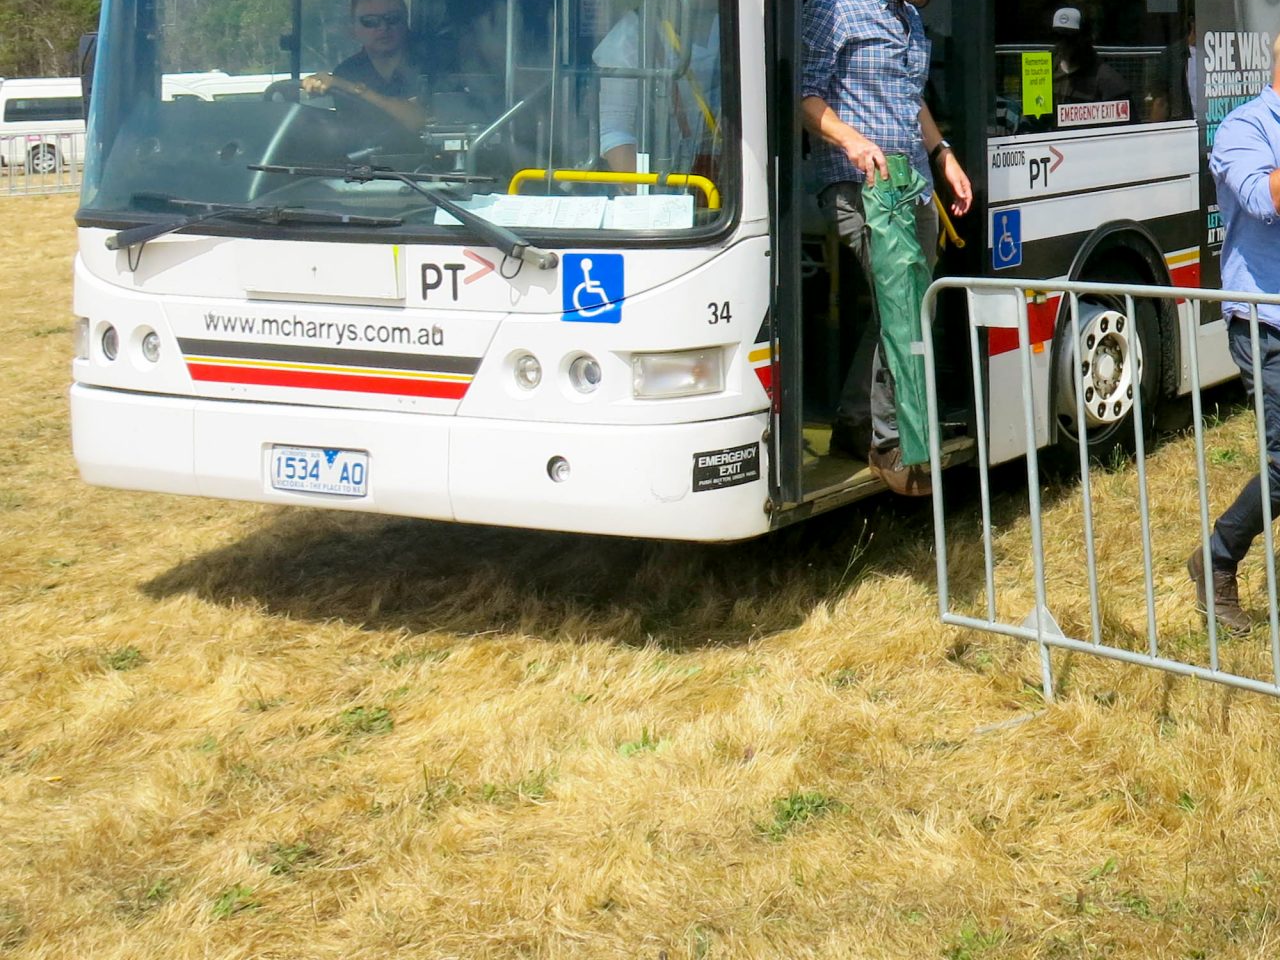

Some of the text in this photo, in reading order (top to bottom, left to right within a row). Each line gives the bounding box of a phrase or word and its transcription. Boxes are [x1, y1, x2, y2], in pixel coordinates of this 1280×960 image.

[1204, 31, 1272, 72] SHE WAS
[1205, 72, 1242, 97] ASKING
[1243, 71, 1261, 95] FOR
[1060, 103, 1115, 123] EMERGENCY EXIT
[1206, 97, 1231, 122] JUST
[1029, 156, 1051, 190] PT
[420, 262, 467, 302] PT
[707, 301, 733, 324] 34
[203, 313, 445, 346] www.mcharrys.com.au
[276, 456, 320, 482] 1534
[698, 446, 757, 468] EMERGENCY
[719, 462, 742, 476] EXIT
